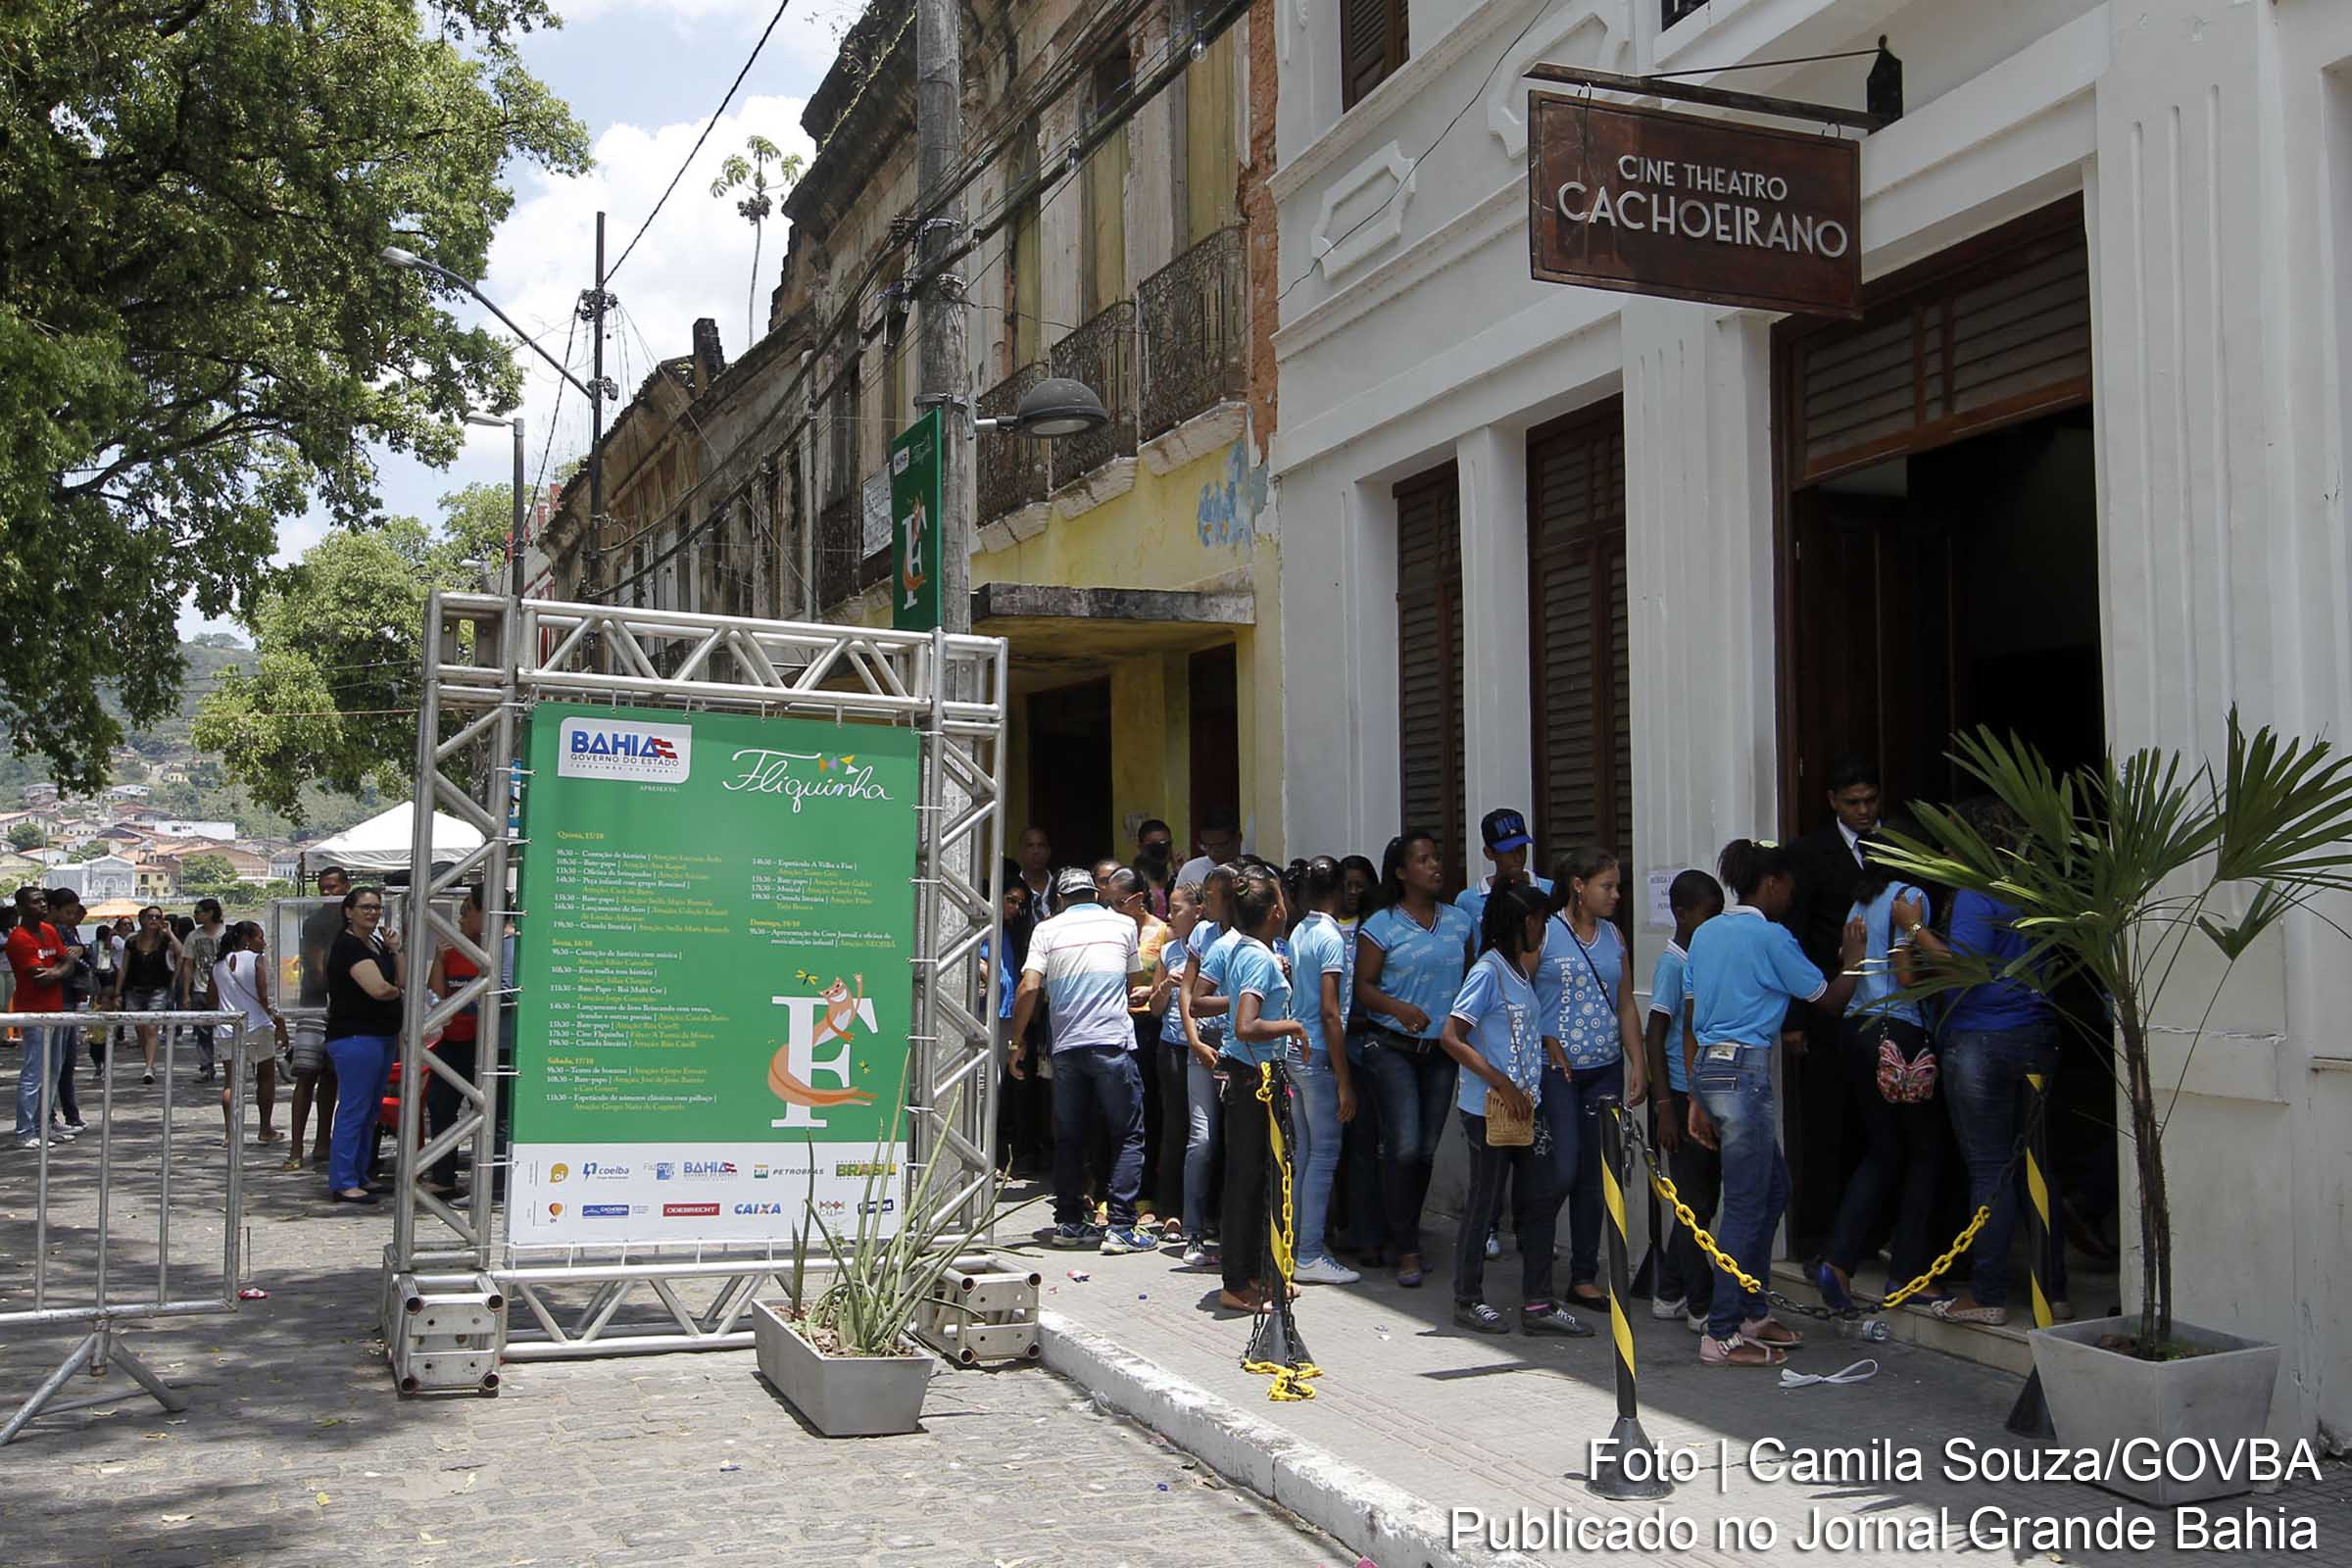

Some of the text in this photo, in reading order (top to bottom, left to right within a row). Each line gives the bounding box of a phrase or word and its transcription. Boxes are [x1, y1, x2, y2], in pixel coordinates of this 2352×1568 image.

[1618, 154, 1788, 201] CINE THEATRO
[1557, 180, 1848, 259] CACHOEIRANO
[571, 730, 661, 759] BAHIA
[570, 753, 619, 763] GOVERNO
[722, 748, 894, 813] Fliquinha
[599, 1163, 629, 1175] coelba
[684, 1161, 727, 1174] BAHIA
[666, 1205, 716, 1214] ODEBRECHT
[734, 1202, 782, 1215] CAIXA
